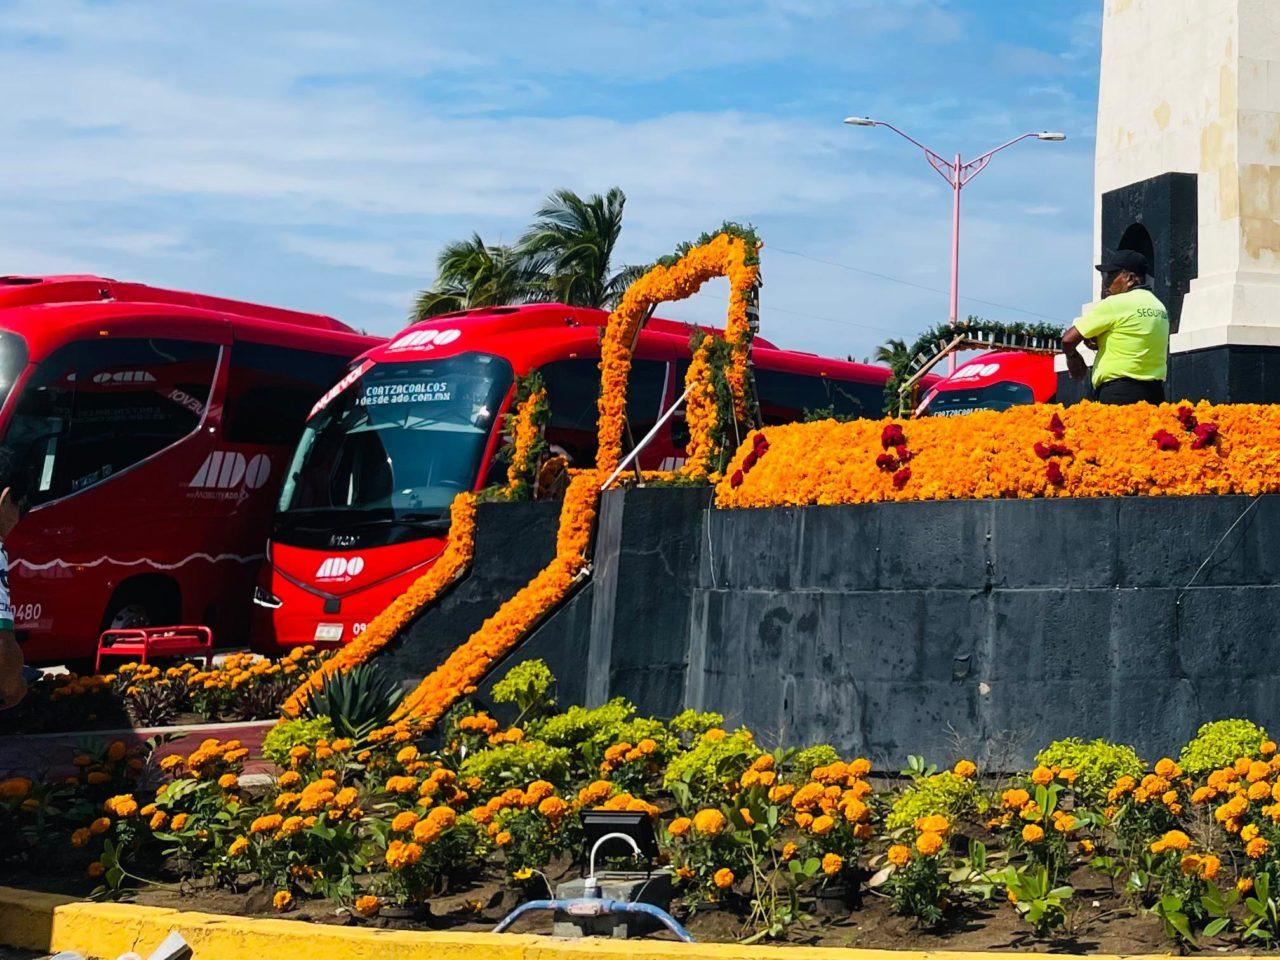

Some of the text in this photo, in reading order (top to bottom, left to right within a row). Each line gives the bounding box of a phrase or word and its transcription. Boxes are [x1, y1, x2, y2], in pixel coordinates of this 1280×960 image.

[388, 329, 461, 350] ADO
[949, 363, 1000, 380] ADO
[366, 382, 447, 396] COATZACOALCOS
[188, 451, 271, 489] ADO
[315, 556, 364, 577] ADO
